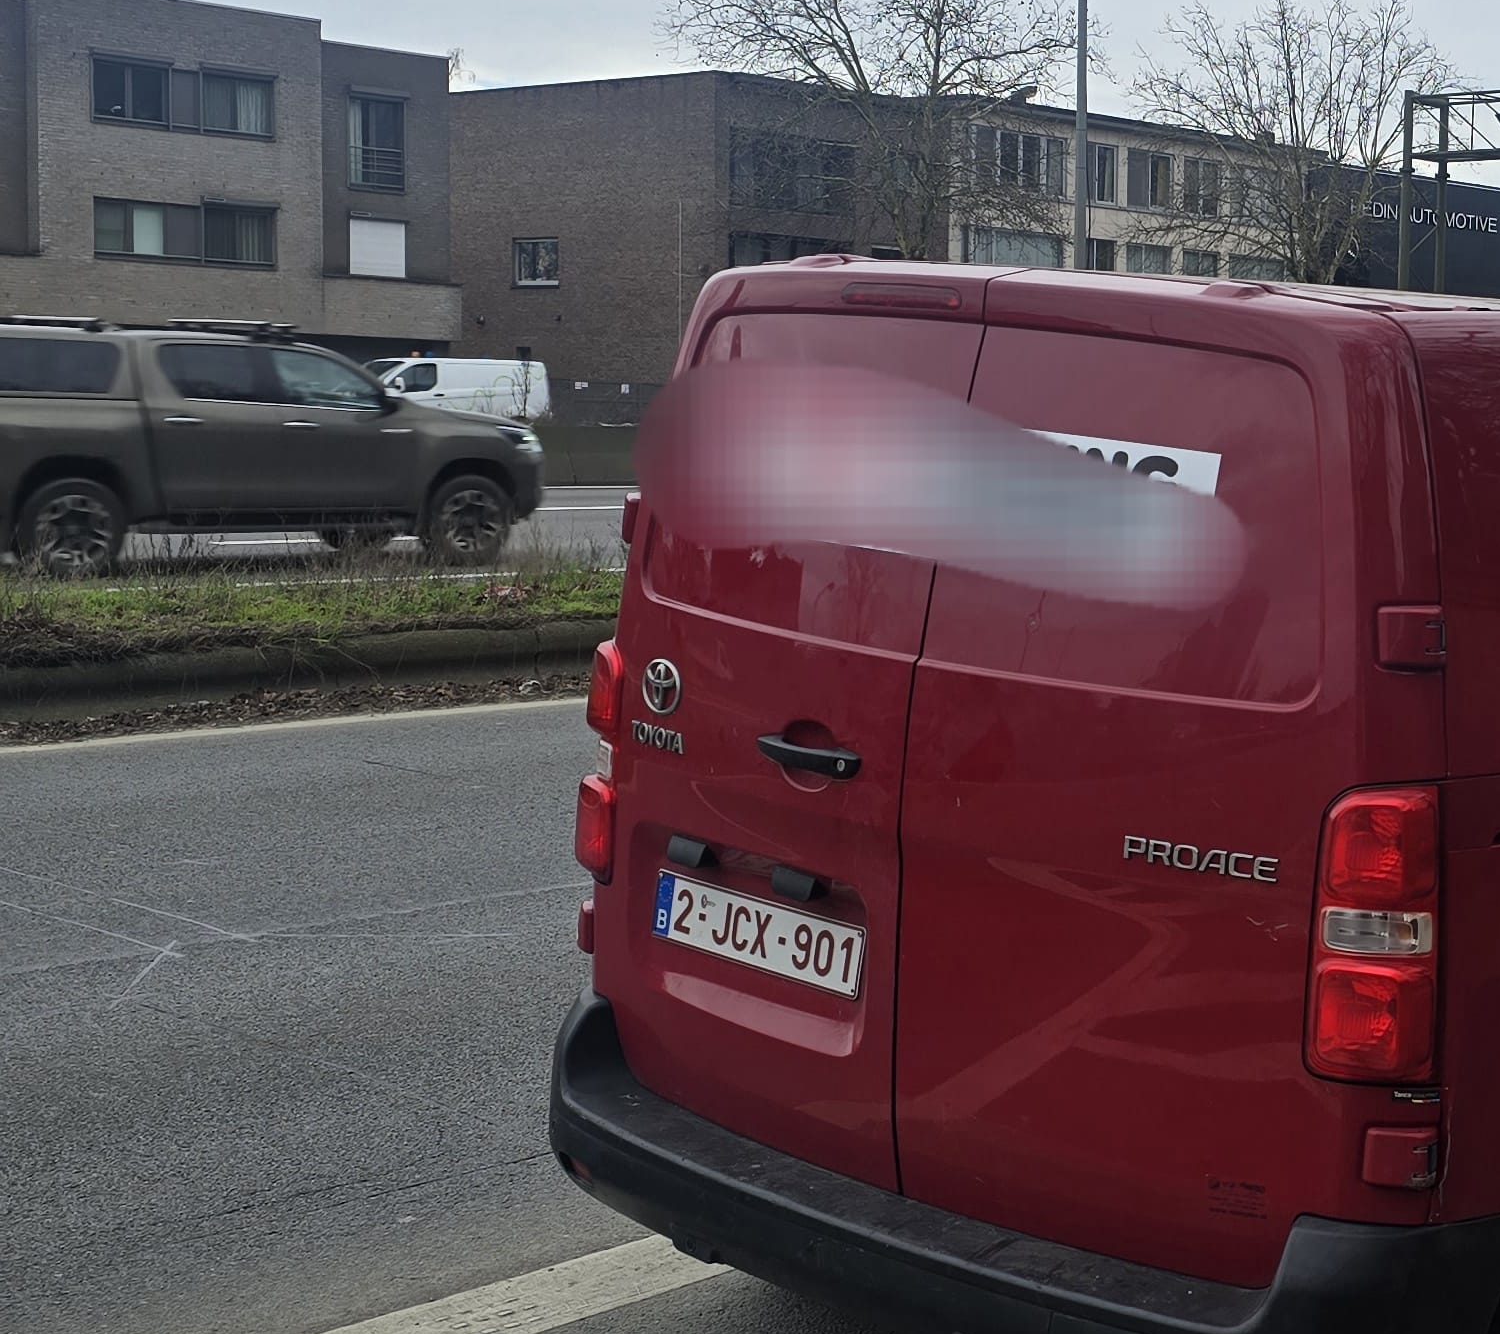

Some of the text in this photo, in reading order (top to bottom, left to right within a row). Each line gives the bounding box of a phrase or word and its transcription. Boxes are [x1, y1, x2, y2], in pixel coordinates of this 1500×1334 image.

[632, 720, 684, 755] TOYOTA
[1123, 835, 1279, 882] PROACE
[656, 908, 667, 930] B
[673, 889, 855, 984] 2-JCX-901
